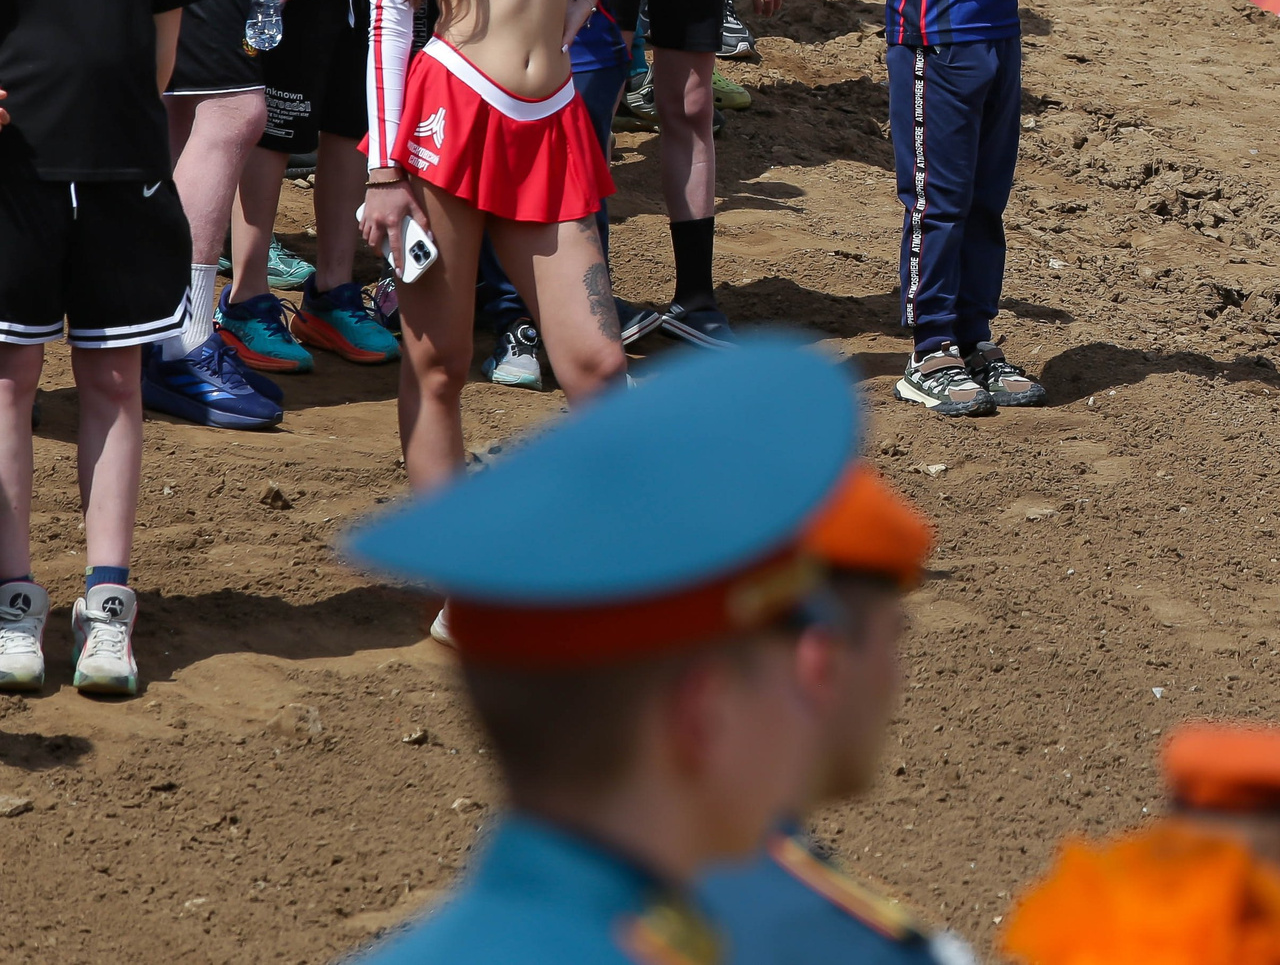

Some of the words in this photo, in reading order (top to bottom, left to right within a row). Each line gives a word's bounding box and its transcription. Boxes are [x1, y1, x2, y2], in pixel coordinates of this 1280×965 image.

[264, 87, 304, 100] nknown
[915, 79, 924, 123] ATMOSPHERE
[915, 126, 925, 168] ATMOSPHERE
[908, 256, 919, 299] ATMOSPHERE
